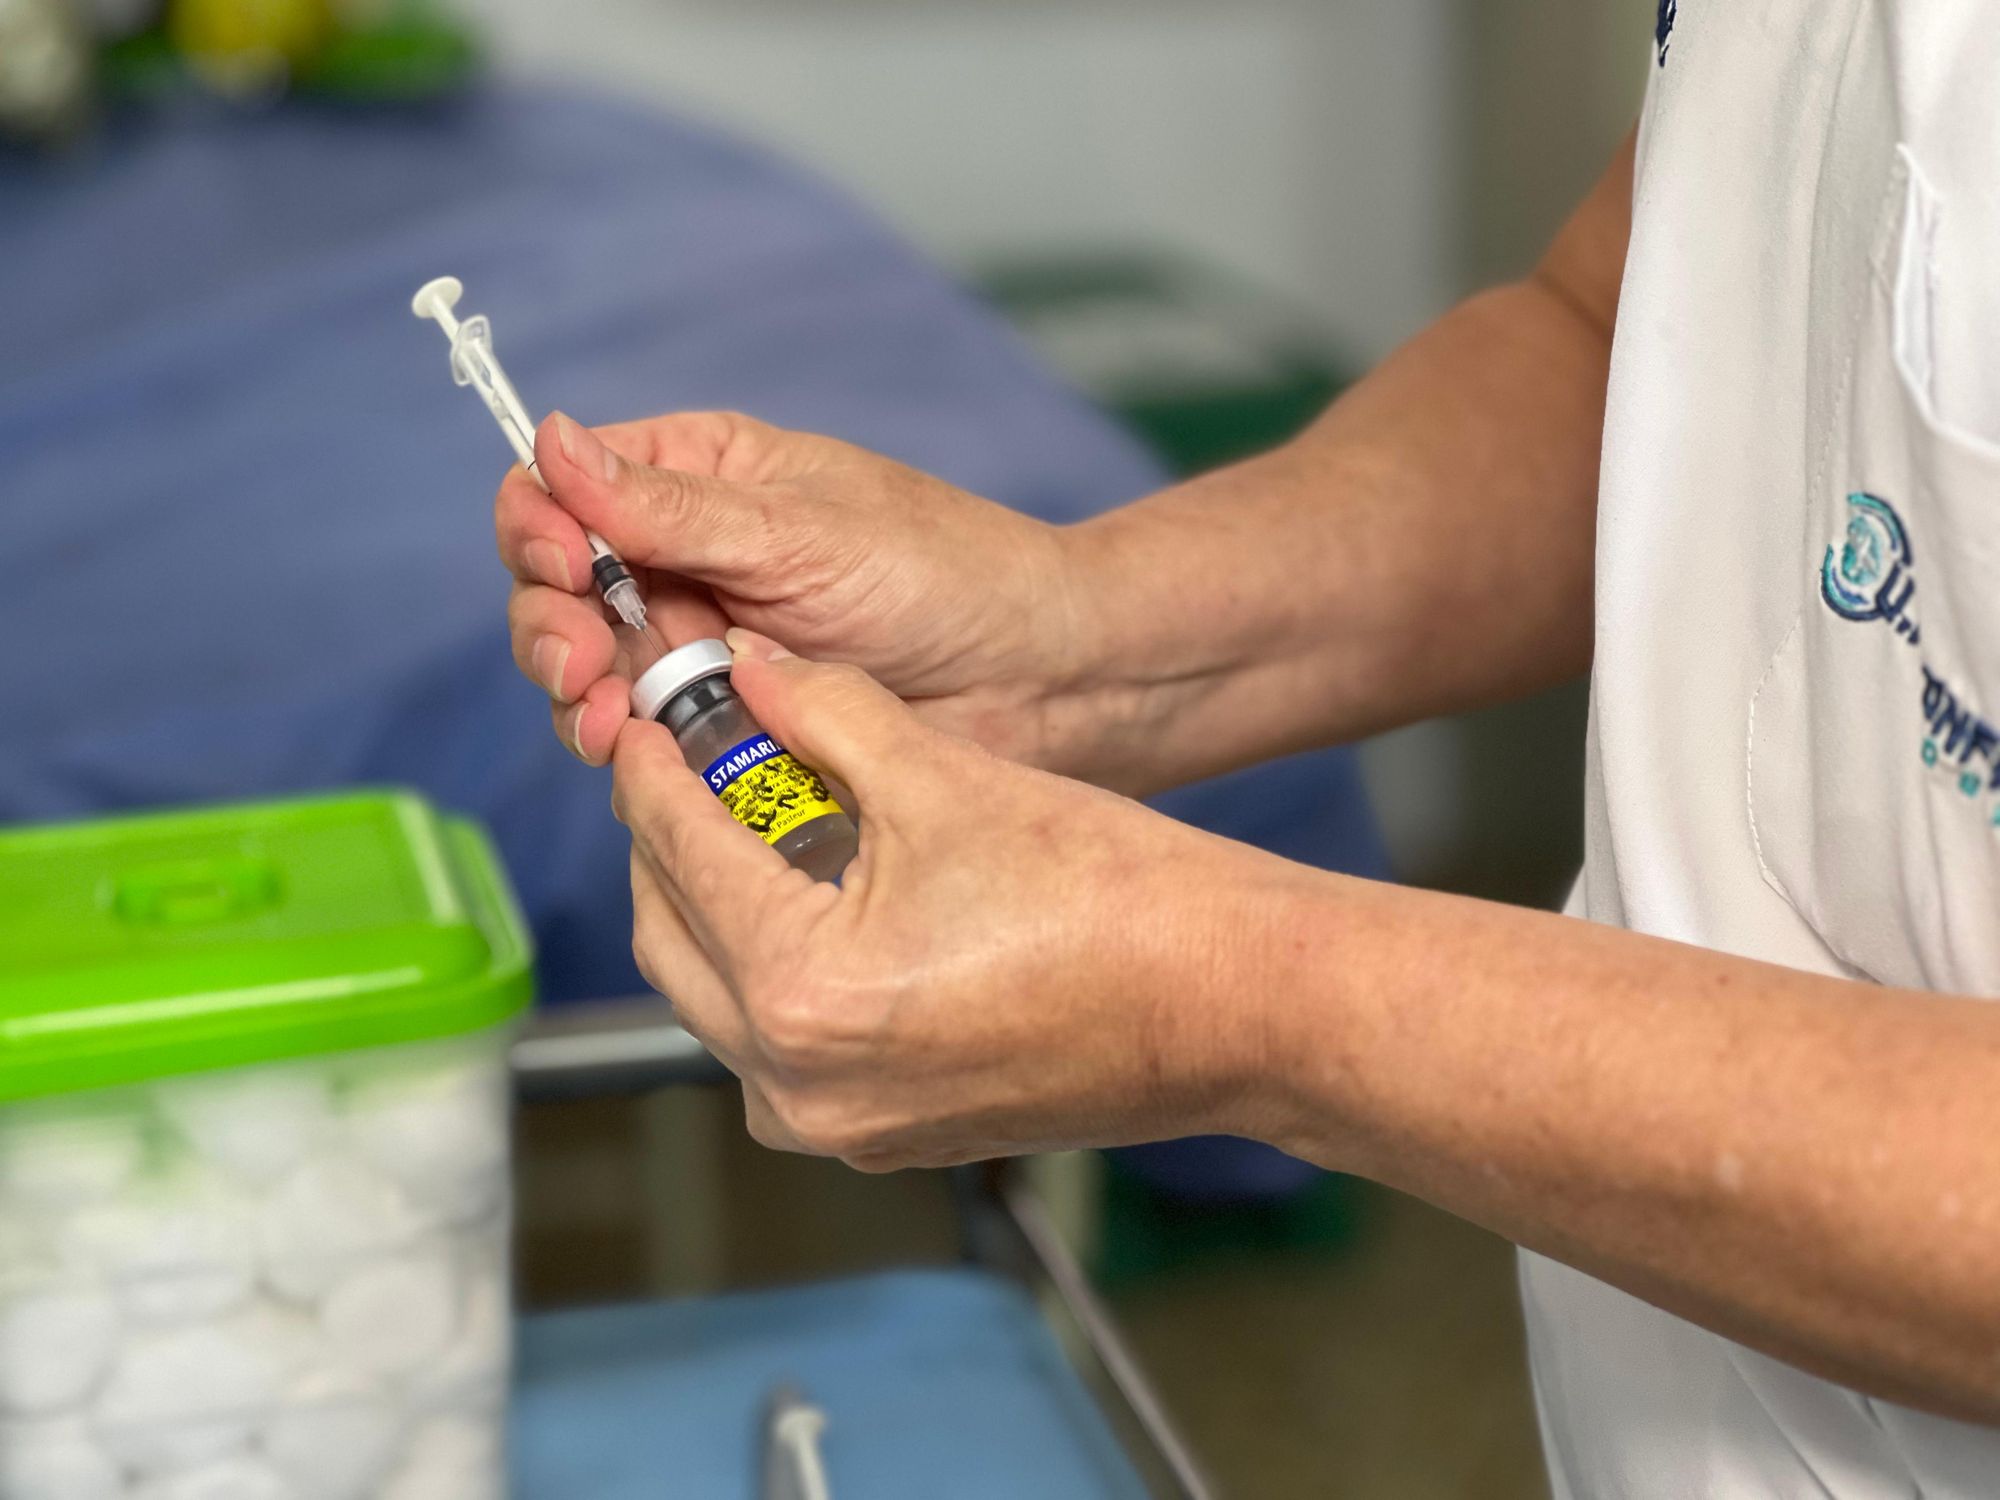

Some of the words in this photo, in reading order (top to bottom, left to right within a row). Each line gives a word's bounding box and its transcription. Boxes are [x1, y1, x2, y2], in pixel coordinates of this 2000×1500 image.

[711, 739, 782, 789] STAMARI
[761, 826, 777, 841] nofi
[776, 809, 806, 828] Pasteur
